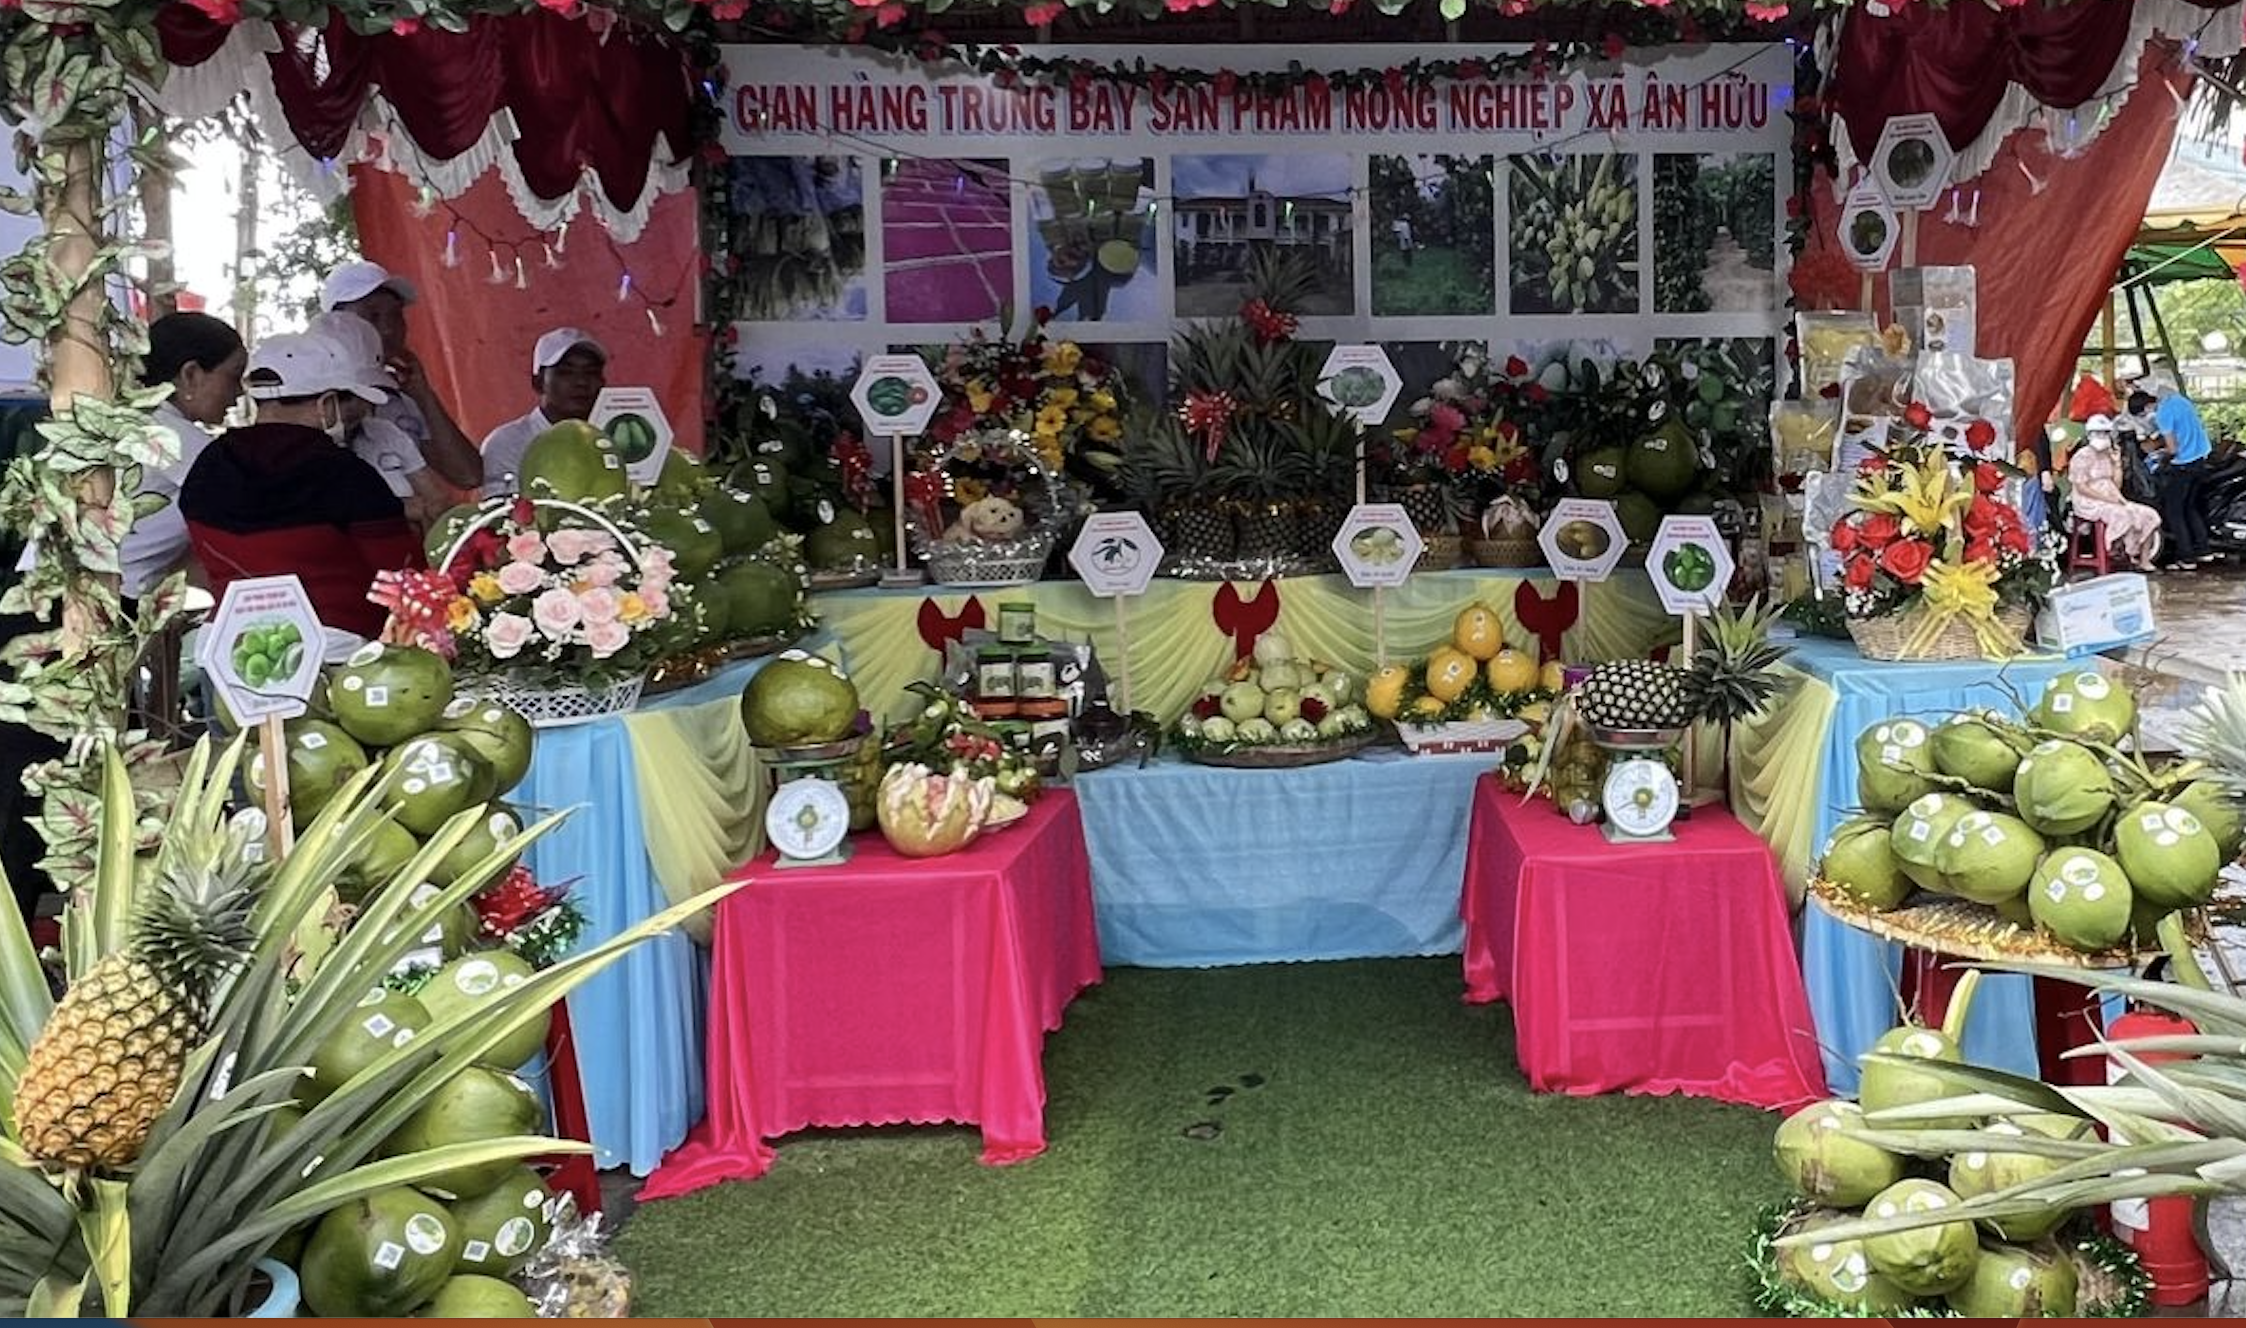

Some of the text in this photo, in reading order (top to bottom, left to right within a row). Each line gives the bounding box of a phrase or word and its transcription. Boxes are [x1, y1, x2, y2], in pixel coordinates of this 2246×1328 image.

[736, 84, 817, 132] GIAN
[831, 71, 927, 132] HÀNG
[1586, 73, 1628, 129] XÃ
[1642, 71, 1687, 129] ÂN
[1700, 70, 1768, 129] HỮU
